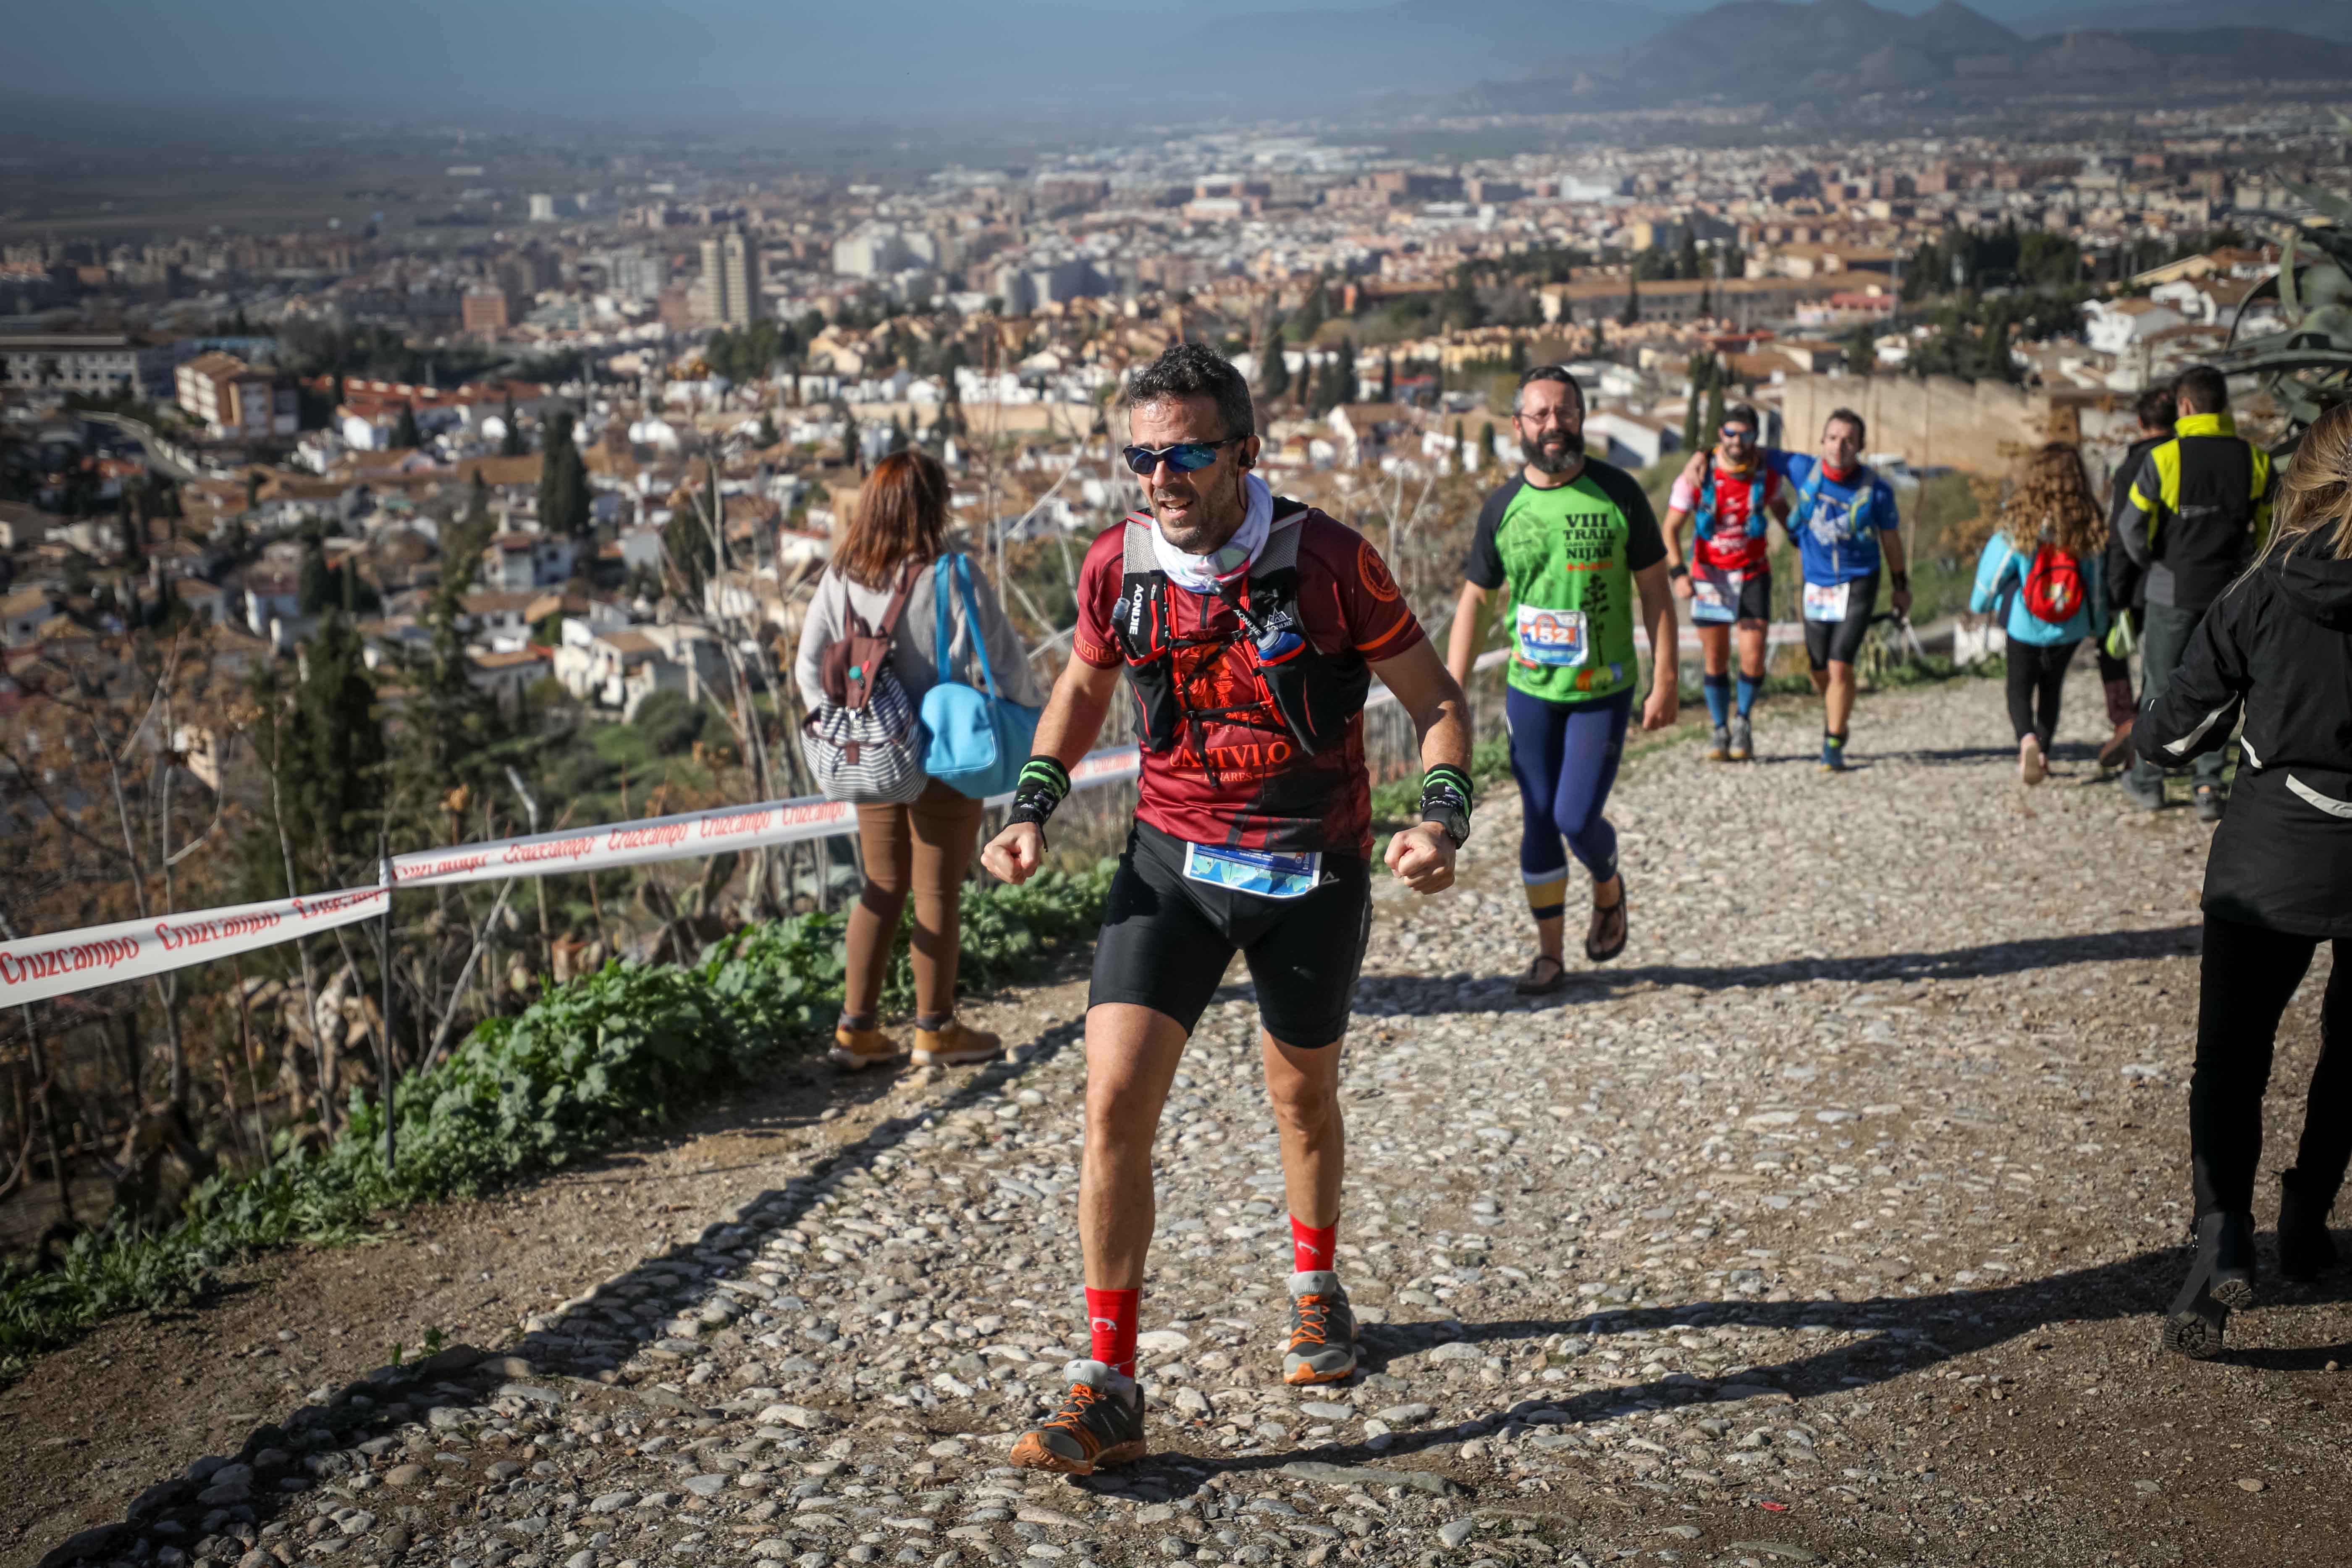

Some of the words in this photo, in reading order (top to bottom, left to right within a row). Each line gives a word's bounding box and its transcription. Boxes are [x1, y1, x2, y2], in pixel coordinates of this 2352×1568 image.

[1565, 513, 1608, 528] VIII
[1563, 529, 1616, 540] TRAIL
[1527, 624, 1569, 644] 152
[1203, 772, 1253, 781] LARES
[503, 835, 595, 863] Cruzcampo
[608, 823, 689, 851] Cruzcampo
[700, 810, 772, 838] Cruzcampo
[782, 801, 847, 825] Cruzcampo
[0, 936, 139, 985] Cruzcampo
[155, 910, 281, 950] Cruzcampo
